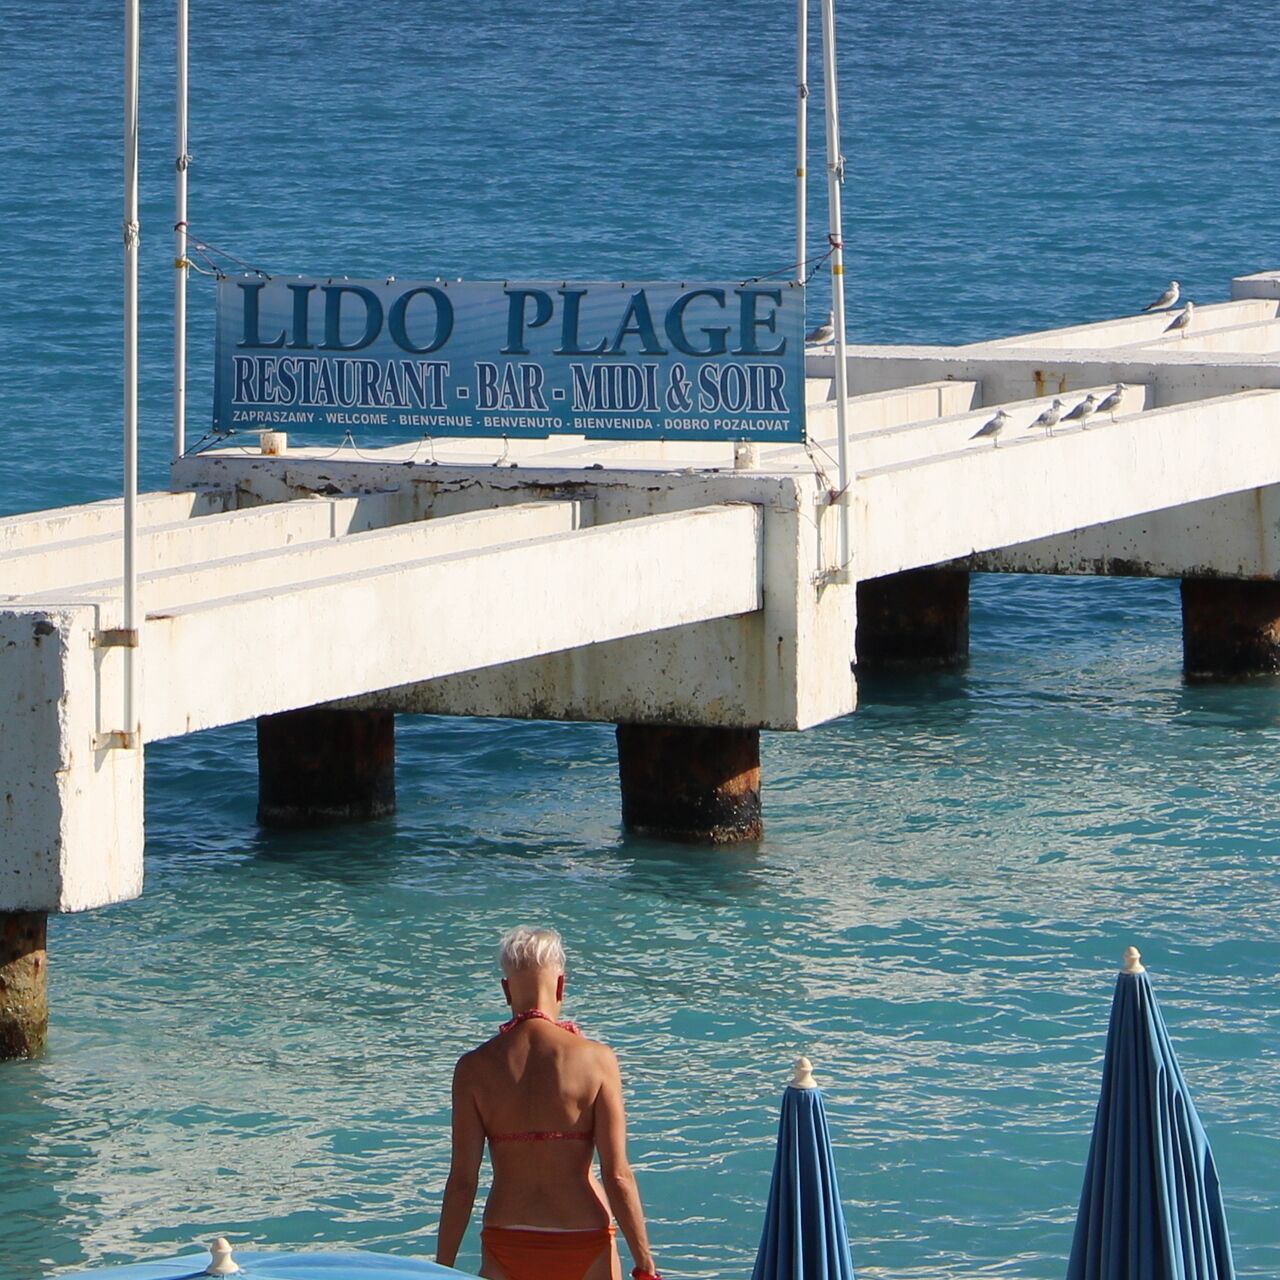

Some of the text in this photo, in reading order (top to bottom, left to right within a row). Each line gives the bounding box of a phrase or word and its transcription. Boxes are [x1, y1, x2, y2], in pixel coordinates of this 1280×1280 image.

[237, 282, 787, 357] LIDO PLAGE
[232, 356, 449, 409] RESTAURANT
[474, 362, 548, 412] BAR
[570, 363, 660, 412] MIDI
[666, 364, 693, 413] &
[699, 364, 789, 414] SOIR
[233, 410, 315, 423] ZAPRASZAMY
[326, 413, 388, 425] WELCOME
[399, 414, 473, 427] BIENVENUE
[484, 416, 563, 428] BENVENUTO
[574, 417, 653, 430] BIENVENIDA
[665, 418, 710, 430] DOBRO
[714, 419, 790, 431] POZALOVAT
